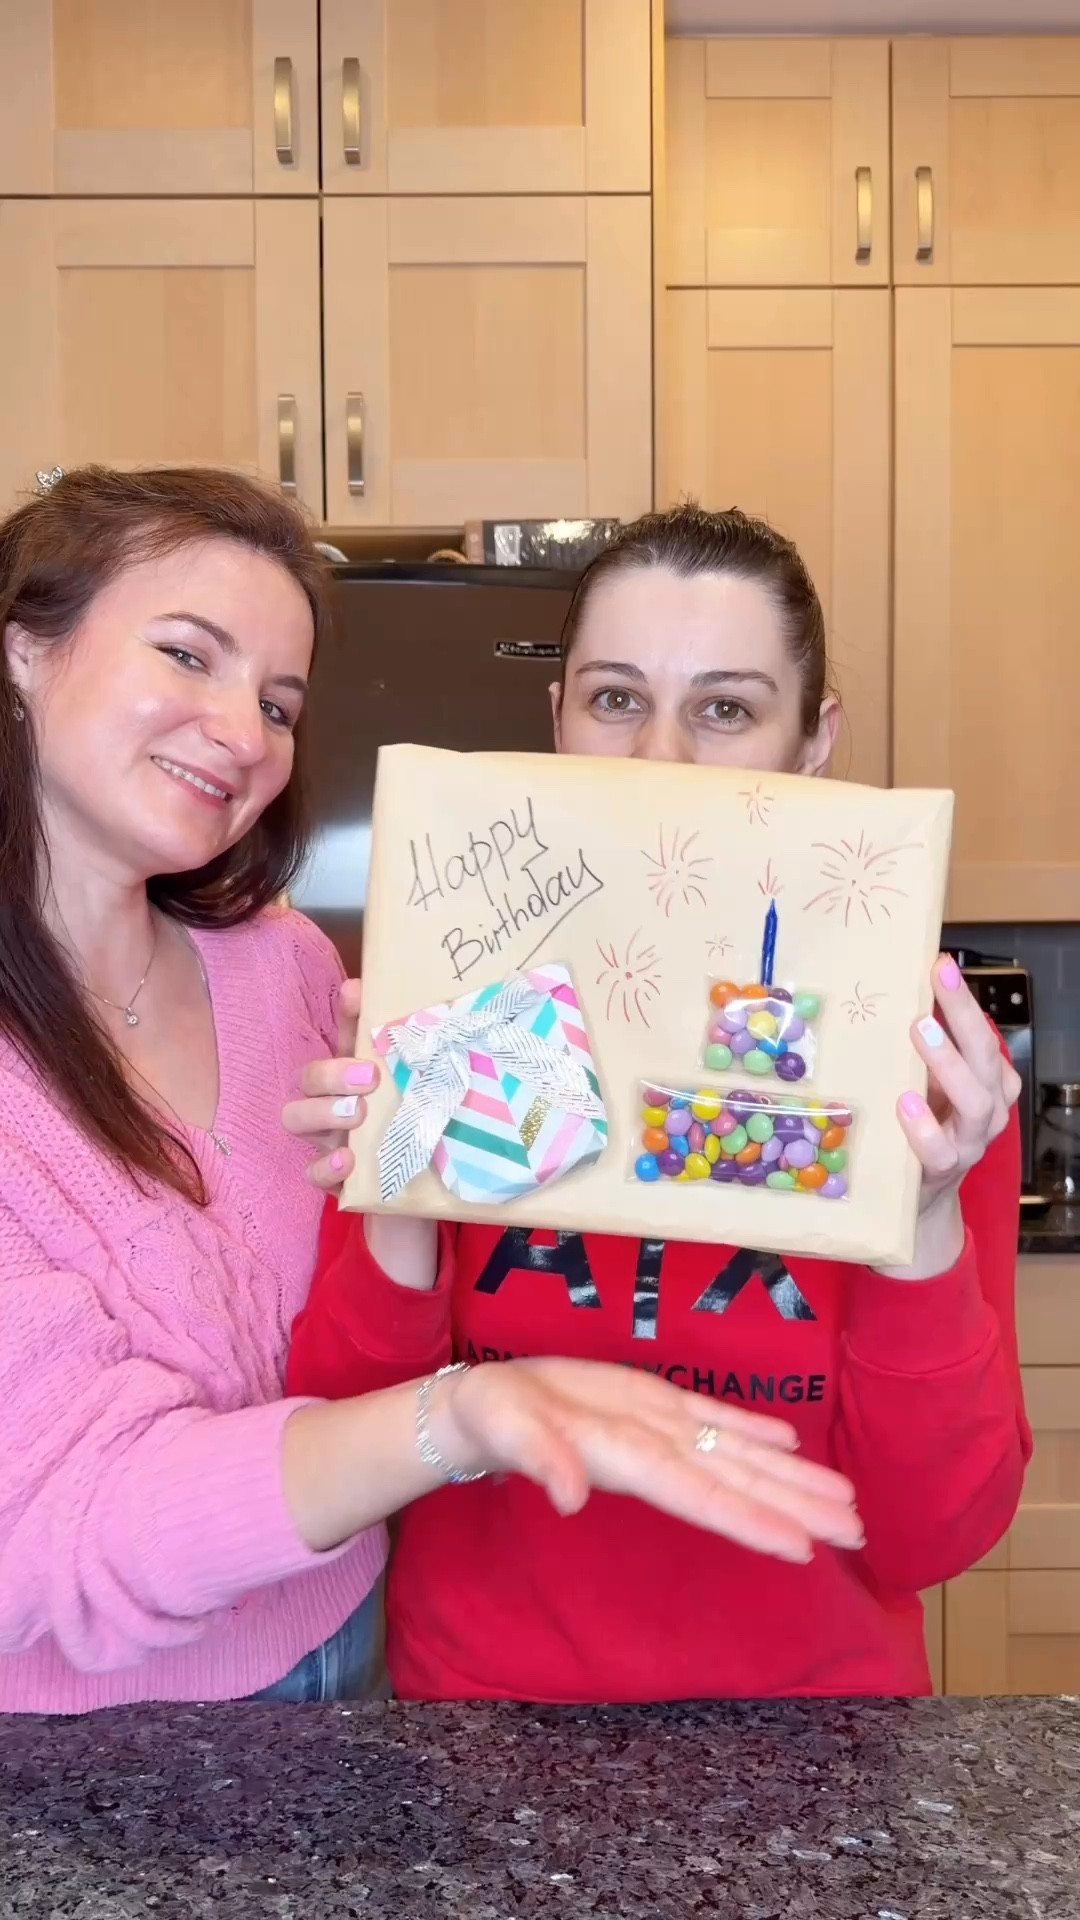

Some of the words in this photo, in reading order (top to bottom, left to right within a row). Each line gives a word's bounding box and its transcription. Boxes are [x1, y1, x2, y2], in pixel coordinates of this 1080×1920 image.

[406, 797, 549, 911] Happy
[441, 848, 604, 981] Birthday
[616, 1360, 827, 1404] CHANGE
